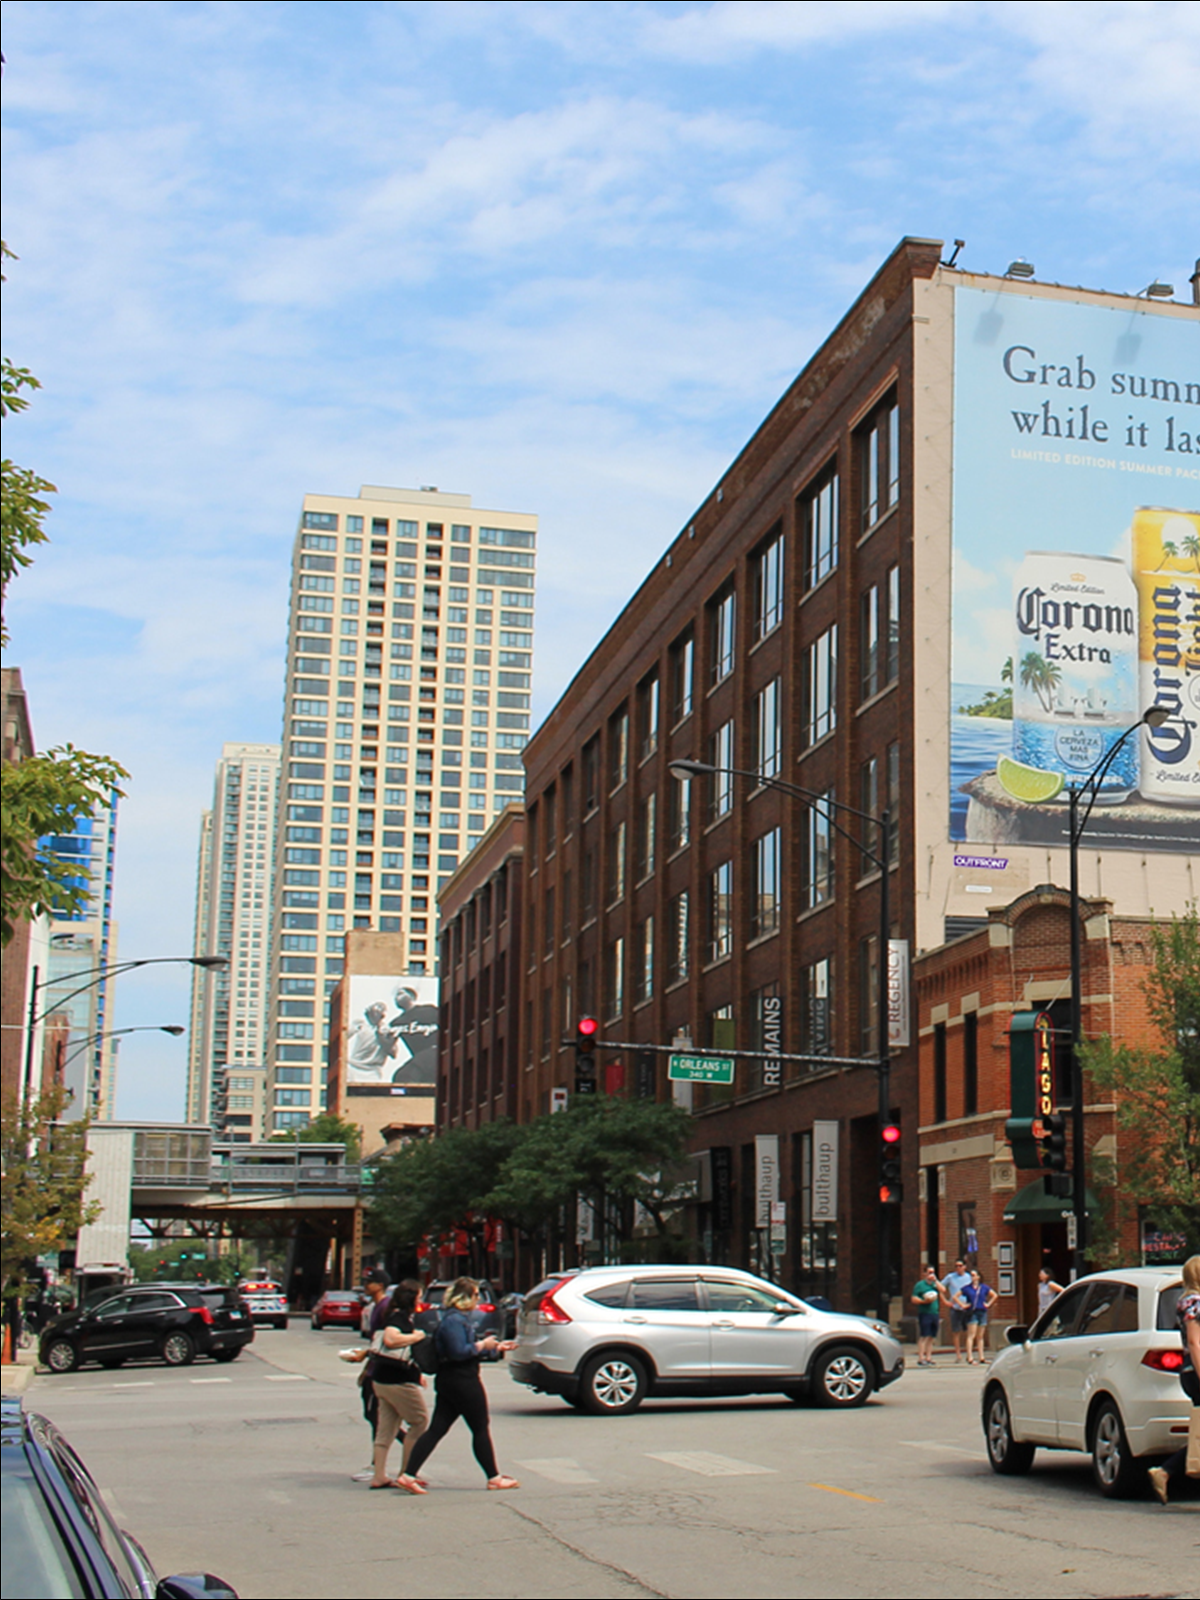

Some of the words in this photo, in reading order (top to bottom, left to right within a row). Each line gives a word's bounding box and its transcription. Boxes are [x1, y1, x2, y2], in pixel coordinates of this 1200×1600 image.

[1003, 345, 1096, 390] Grab
[1011, 400, 1109, 442] while
[1125, 415, 1149, 447] it
[1010, 449, 1061, 464] LIMITED
[1065, 454, 1116, 469] EDITION
[1119, 461, 1172, 476] SUMMER
[1016, 586, 1136, 641] Corona
[1044, 632, 1112, 664] Extra
[1146, 585, 1197, 765] Corona
[1060, 737, 1099, 746] CERVEZA
[956, 857, 1005, 868] OUTFRONT
[888, 947, 900, 1023] REGENCY
[680, 1058, 720, 1071] ORLEANS
[764, 997, 780, 1086] REMAINS
[1041, 1031, 1052, 1116] LAGO
[816, 1142, 835, 1216] bulthaup
